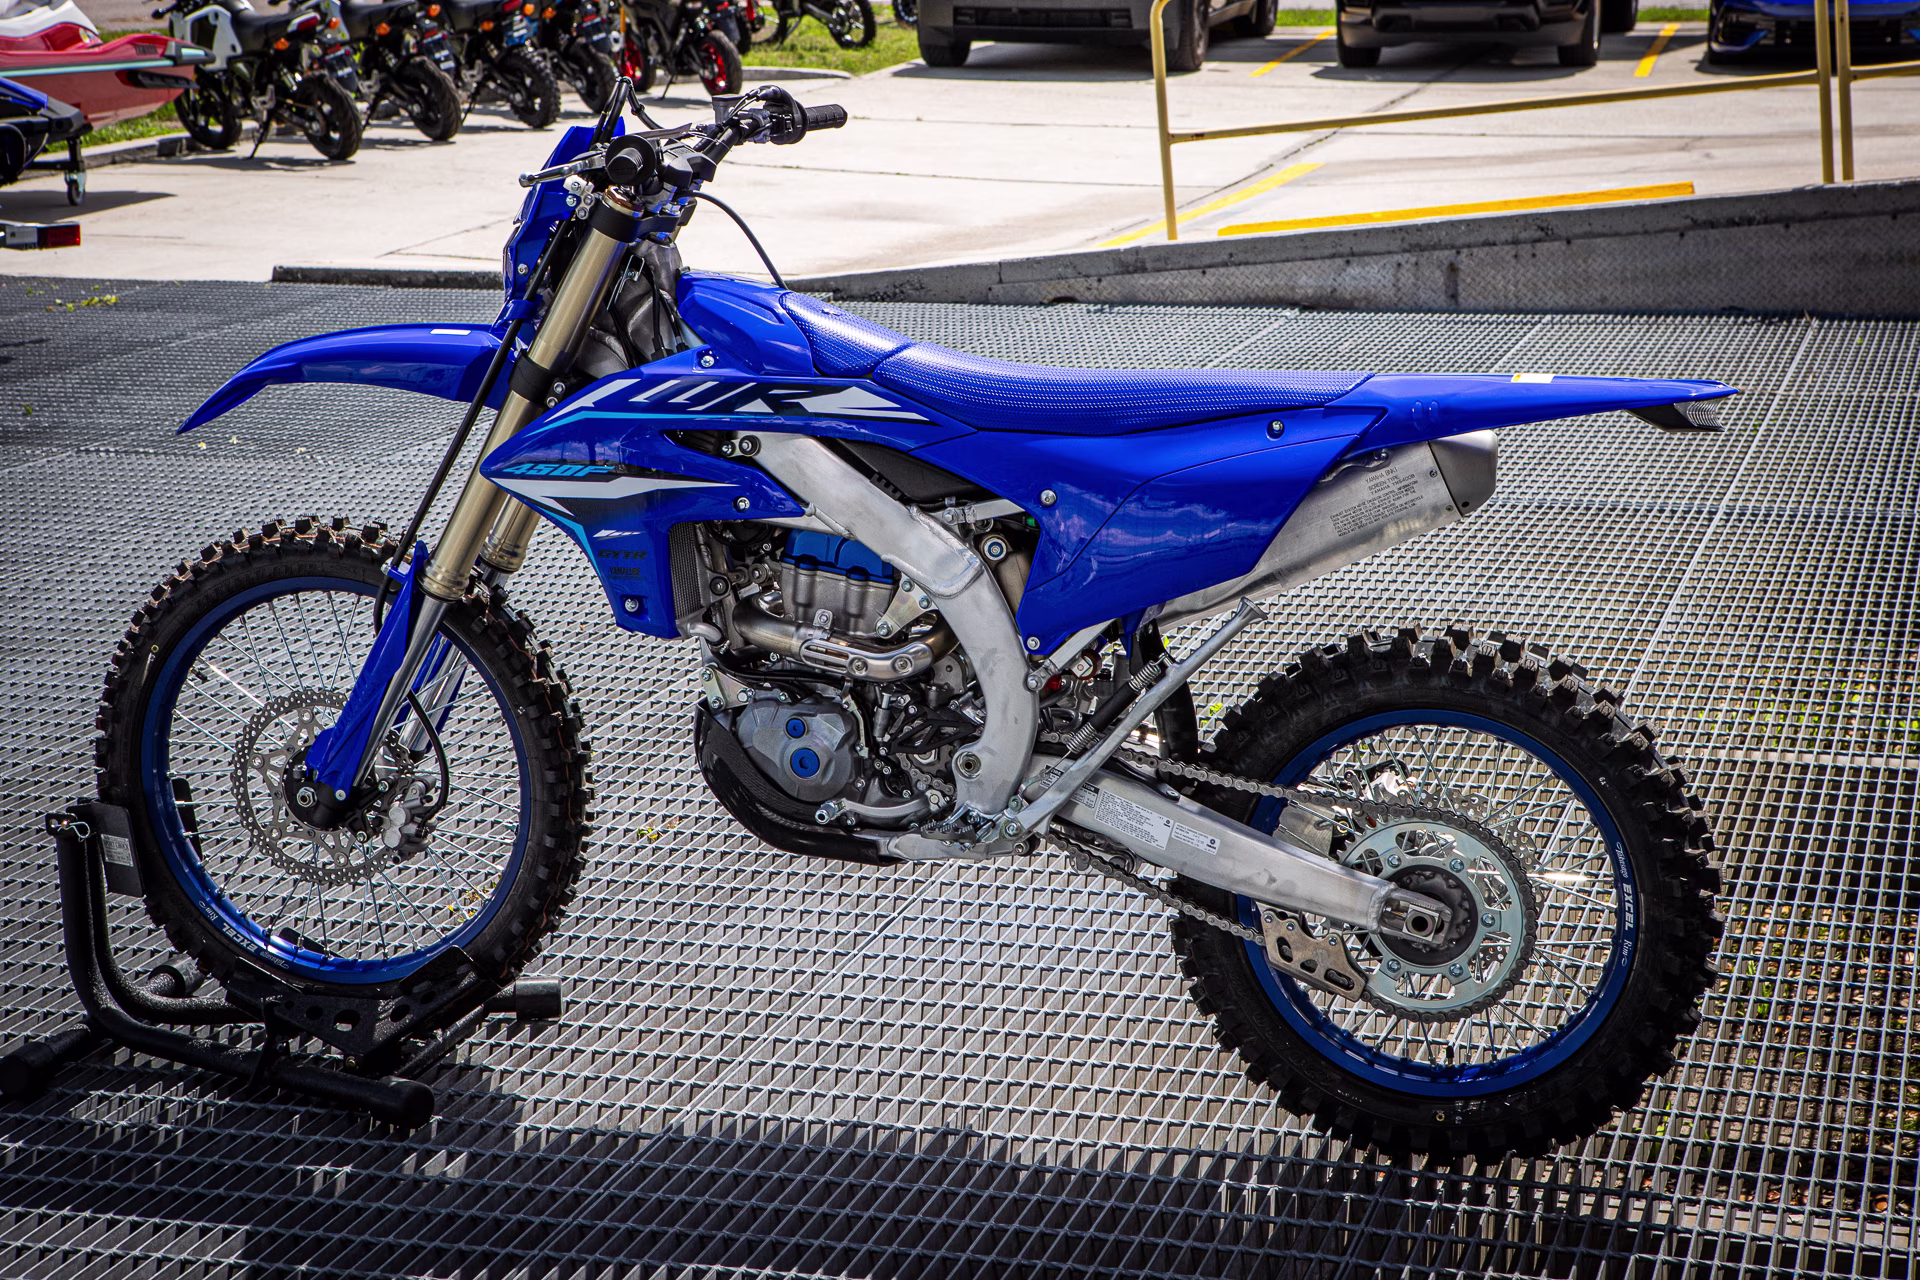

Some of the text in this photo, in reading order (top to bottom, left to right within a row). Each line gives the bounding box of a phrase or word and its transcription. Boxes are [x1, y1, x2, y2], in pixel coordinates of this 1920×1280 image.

[502, 464, 616, 476] 450F
[1364, 472, 1384, 484] YAMAHA
[1387, 474, 1399, 483] TYPE
[1370, 484, 1390, 495] YAMAHA
[598, 550, 647, 559] GYTR
[1622, 882, 1634, 930] EXCEL
[220, 922, 259, 953] EXCEL
